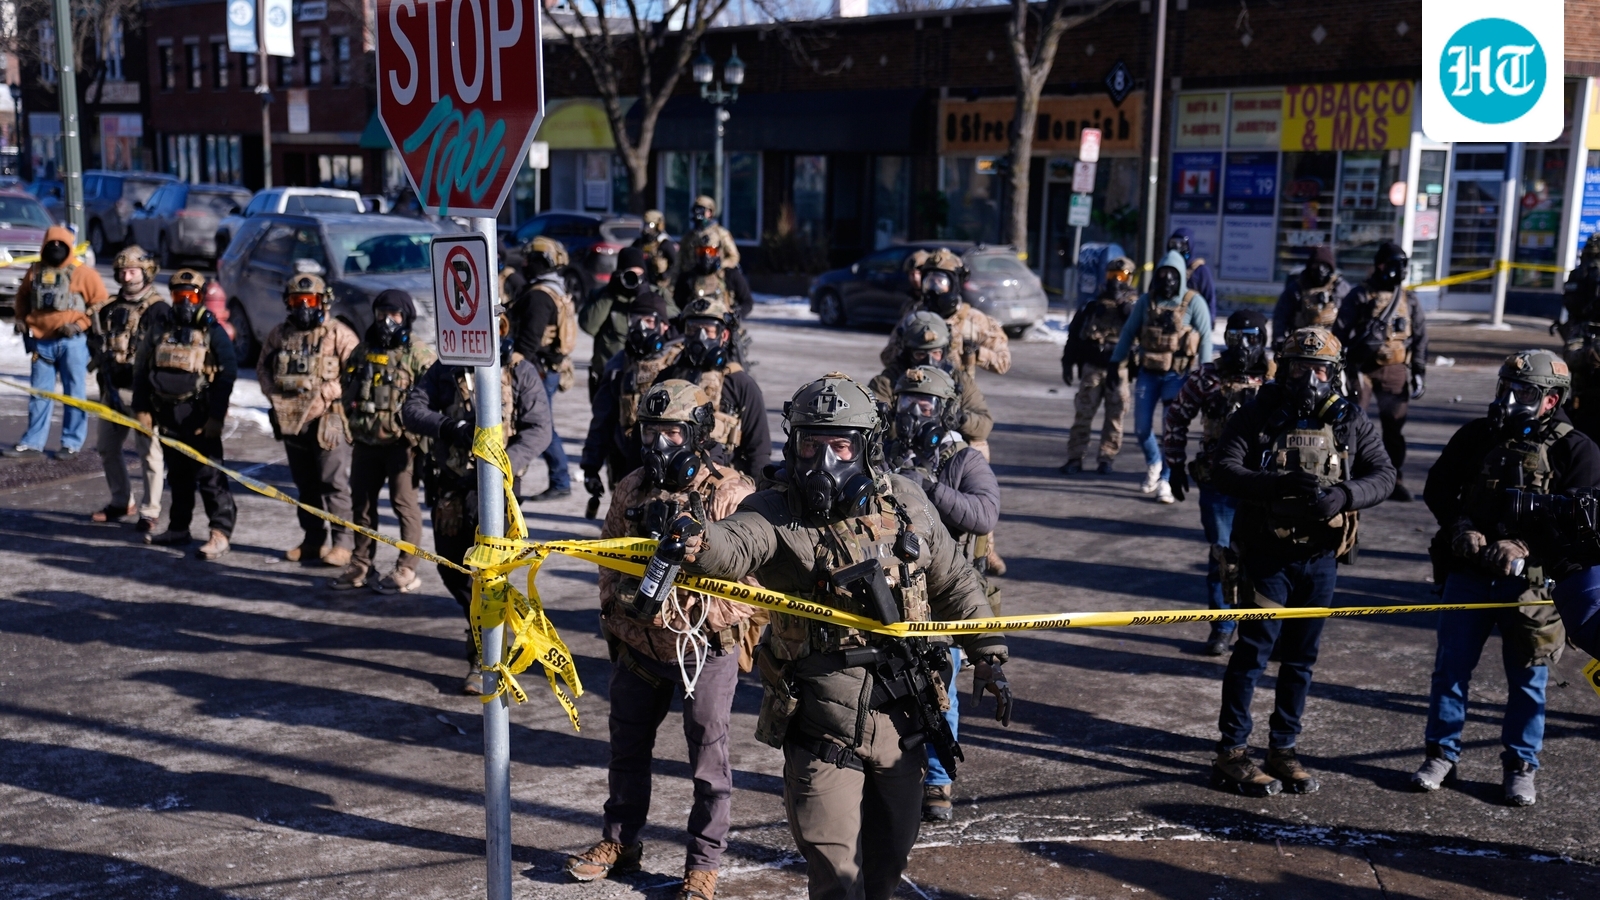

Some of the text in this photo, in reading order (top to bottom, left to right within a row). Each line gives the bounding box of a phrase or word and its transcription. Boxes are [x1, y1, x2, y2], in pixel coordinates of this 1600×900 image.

[388, 0, 523, 105] STOP
[1286, 81, 1411, 118] TOBACCO
[1301, 116, 1388, 151] & MAS
[442, 330, 487, 353] 30 FEET
[695, 578, 728, 594] LINE
[730, 585, 750, 599] DO
[754, 591, 784, 606] NOT
